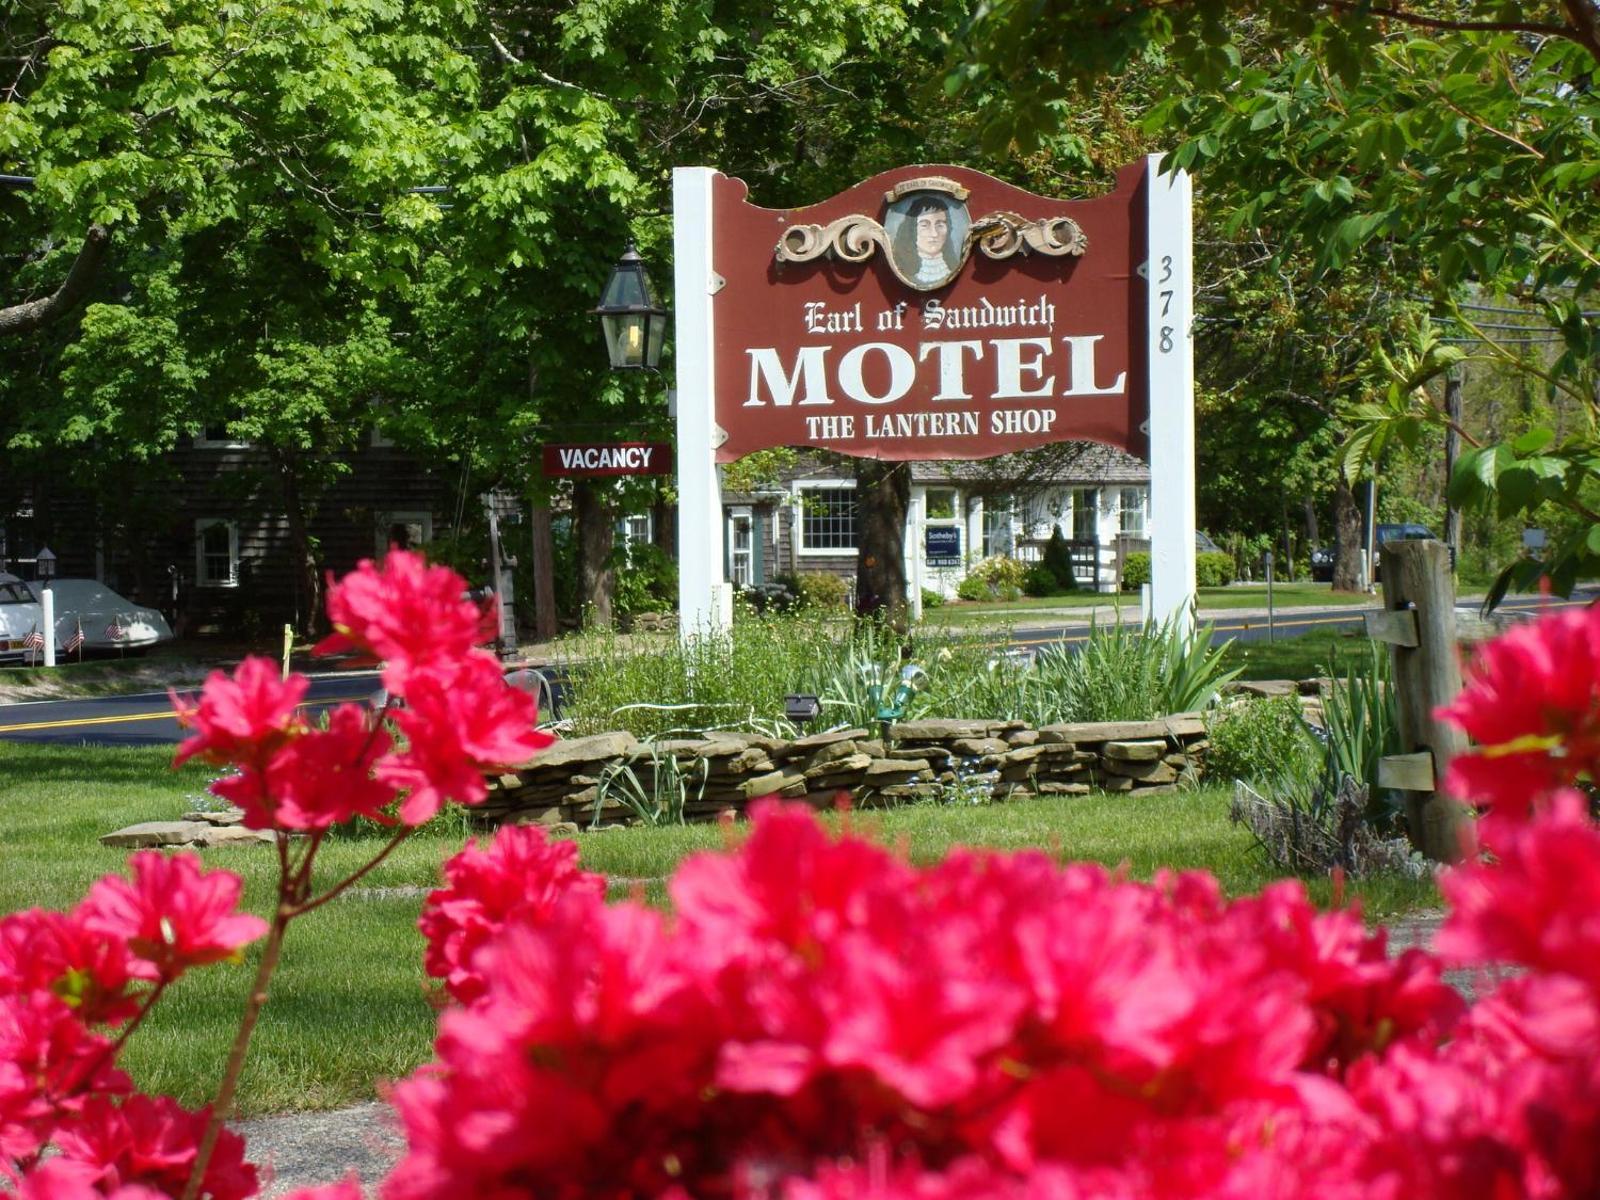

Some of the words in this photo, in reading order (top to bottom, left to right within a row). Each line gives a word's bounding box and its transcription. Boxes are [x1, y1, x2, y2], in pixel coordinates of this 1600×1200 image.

[804, 302, 864, 334] Earl
[877, 302, 908, 332] of
[924, 294, 1056, 333] Sandwich
[742, 335, 1127, 407] MOTEL
[806, 415, 855, 440] THE
[865, 411, 980, 438] LANTERN
[991, 409, 1057, 434] SHOP
[560, 447, 652, 469] VACANCY
